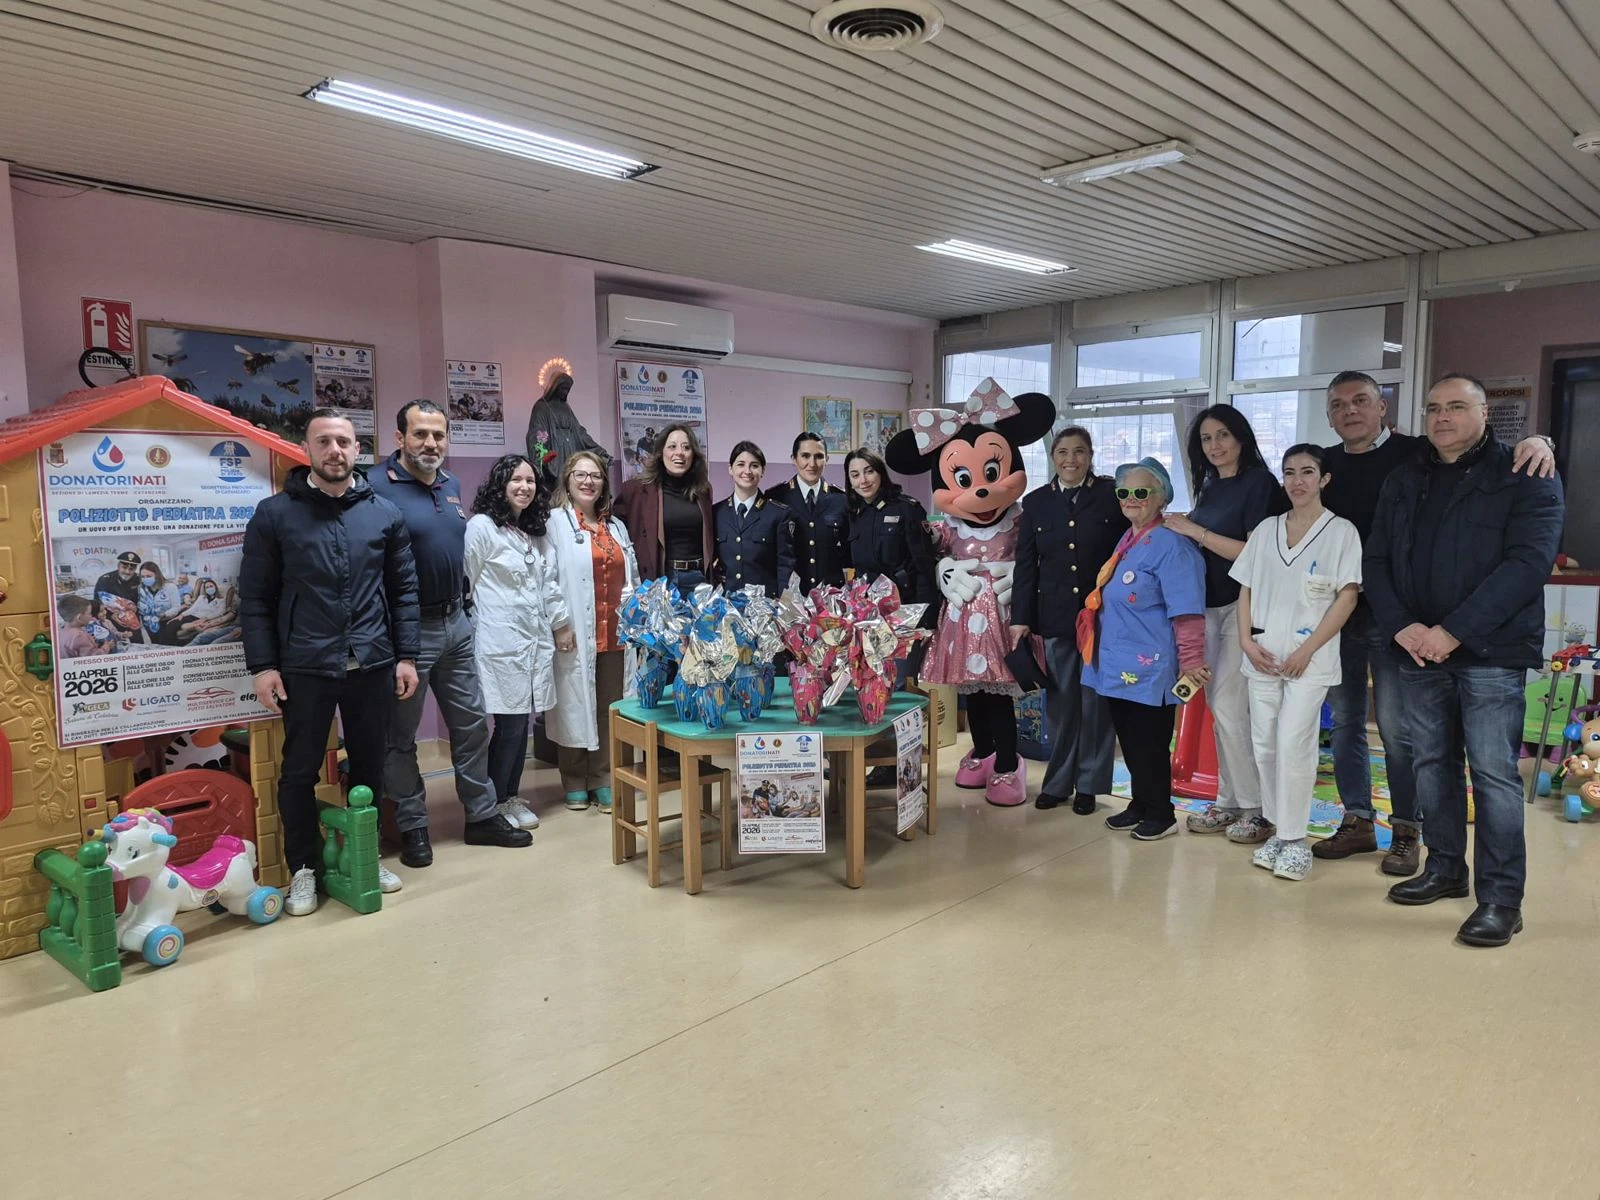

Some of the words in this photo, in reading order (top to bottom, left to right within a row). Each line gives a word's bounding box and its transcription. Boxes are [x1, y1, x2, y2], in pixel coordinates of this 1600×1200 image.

[86, 354, 133, 367] ESTINTOE
[219, 458, 242, 467] FSP
[49, 475, 166, 486] DONATORINATI
[58, 507, 149, 523] POLIZIOTTO
[152, 506, 226, 521] PEDIATRA
[229, 506, 255, 520] 202
[226, 534, 246, 544] SANG
[72, 547, 118, 556] PEDIATRIA
[73, 657, 102, 666] PRESSO
[103, 655, 138, 664] OSPEDALE
[185, 656, 215, 664] DONATORI
[63, 672, 77, 681] 01
[79, 667, 118, 679] APRILE
[183, 671, 214, 679] CONSEGNA
[64, 676, 118, 698] 2026
[140, 694, 180, 706] LIGATO
[120, 720, 166, 730] COLLABORAZIONE
